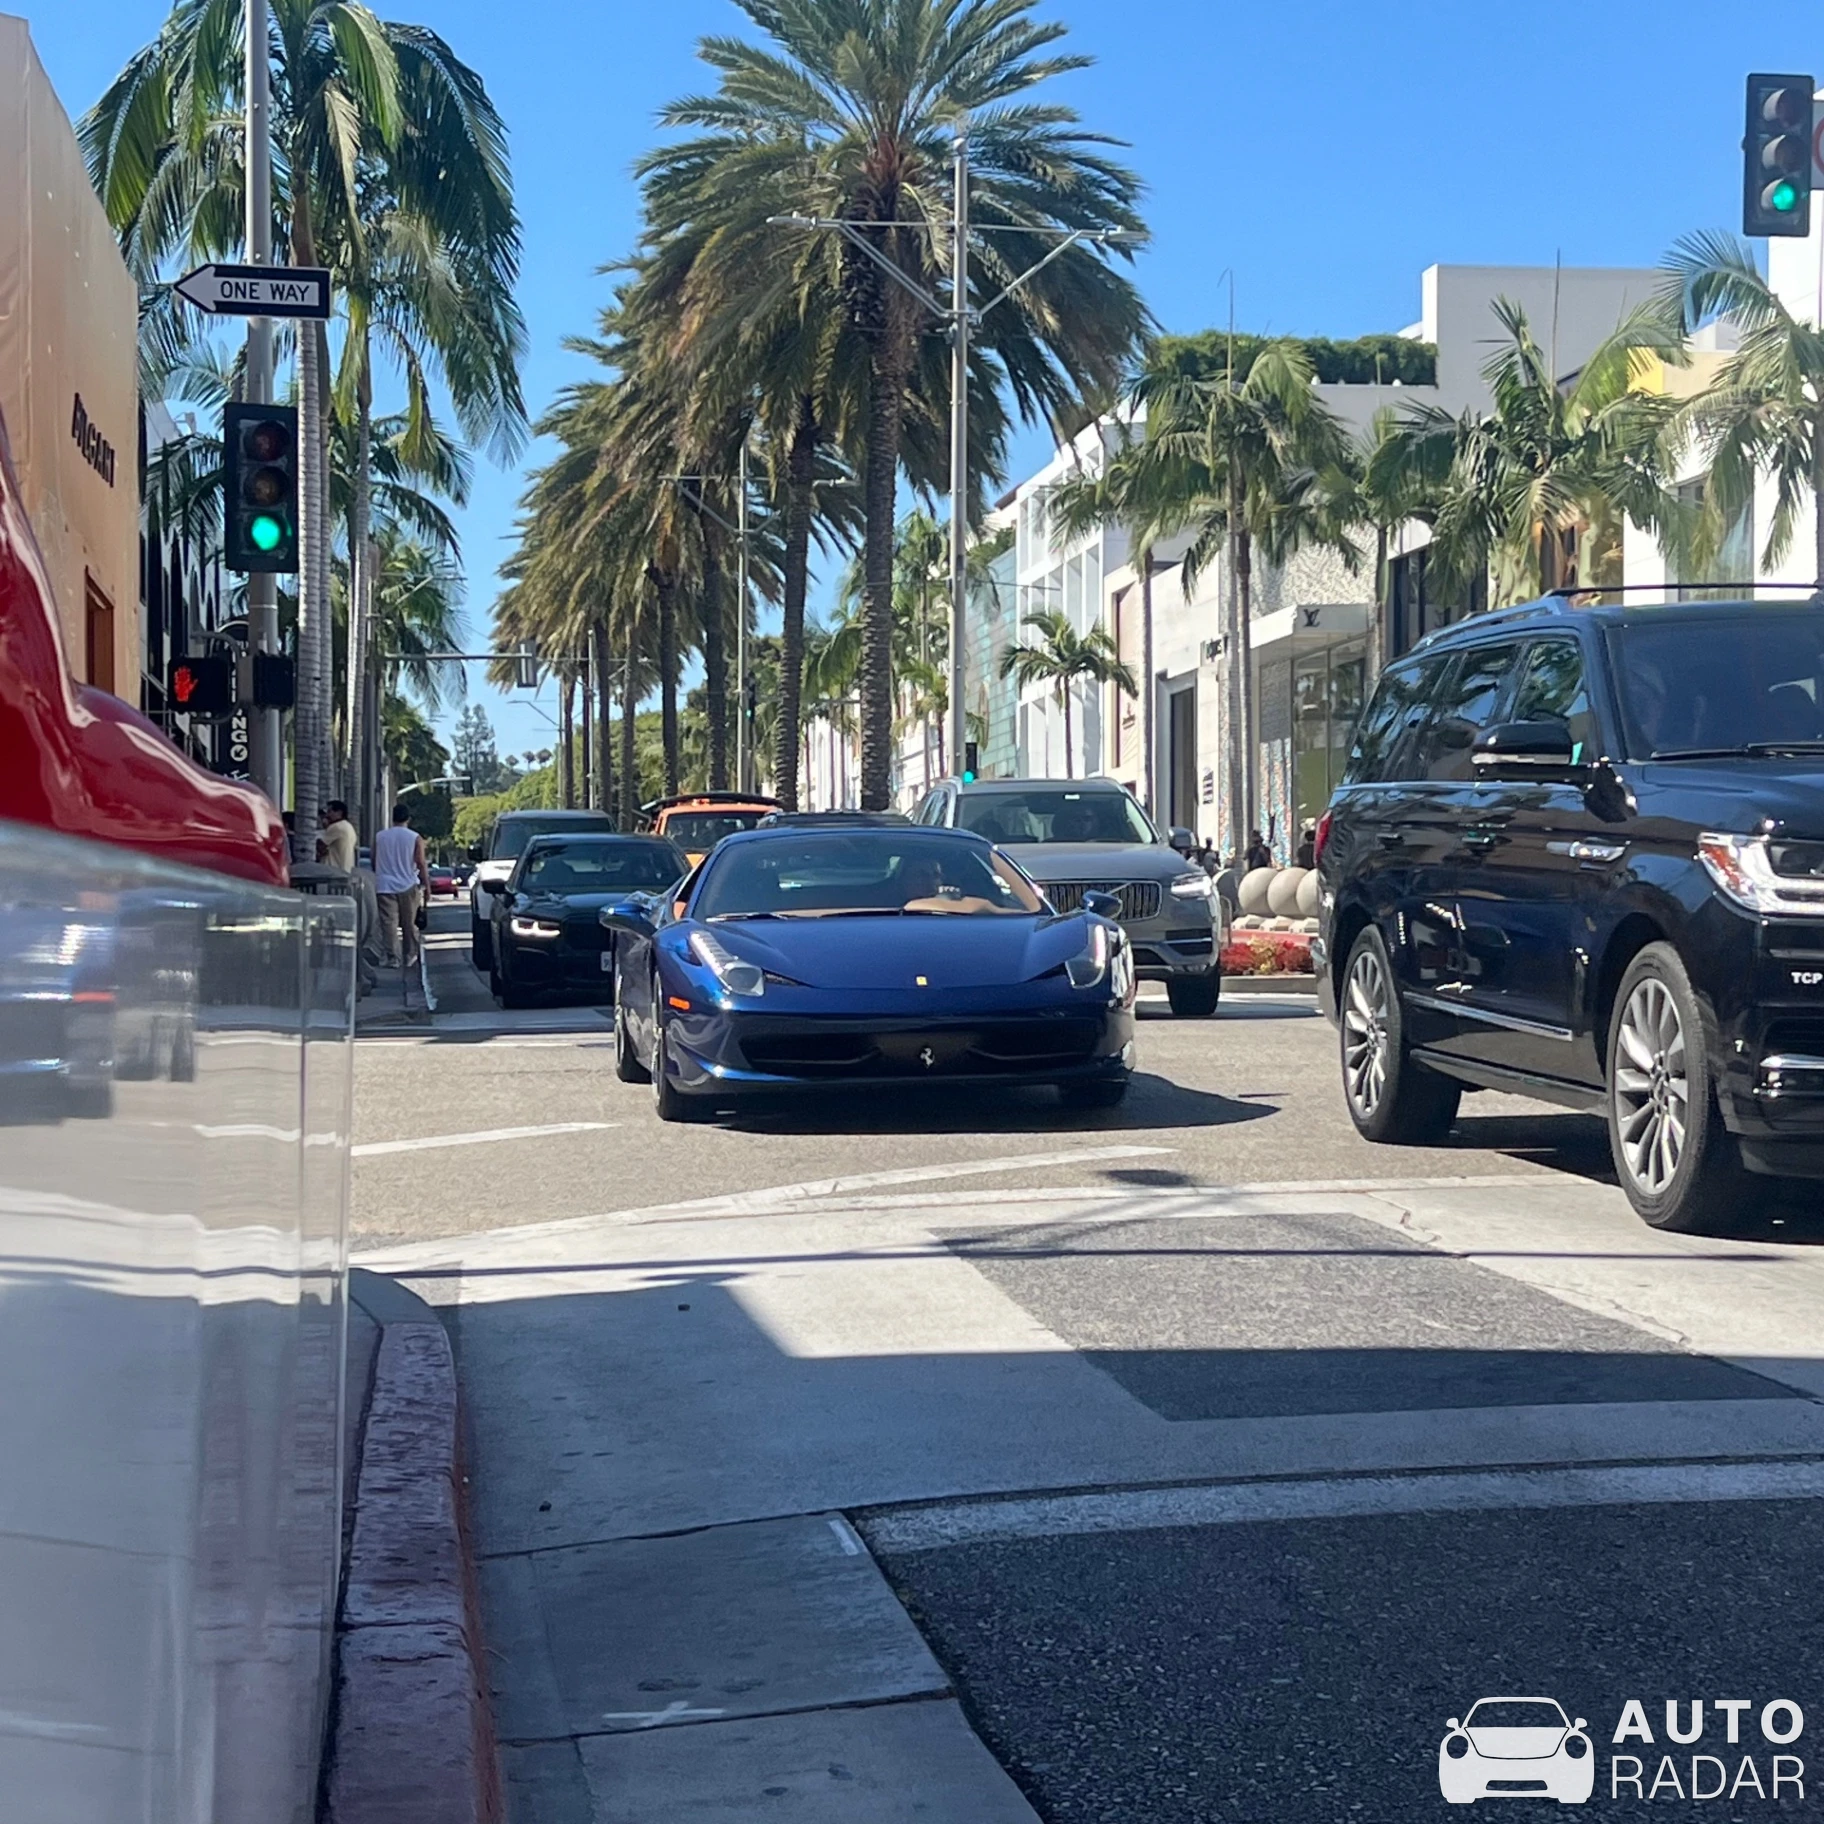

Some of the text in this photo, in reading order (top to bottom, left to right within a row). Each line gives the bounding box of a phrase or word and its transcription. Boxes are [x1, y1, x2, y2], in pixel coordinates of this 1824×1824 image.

[220, 280, 310, 302] ONE WAY
[1790, 971, 1824, 985] TCP
